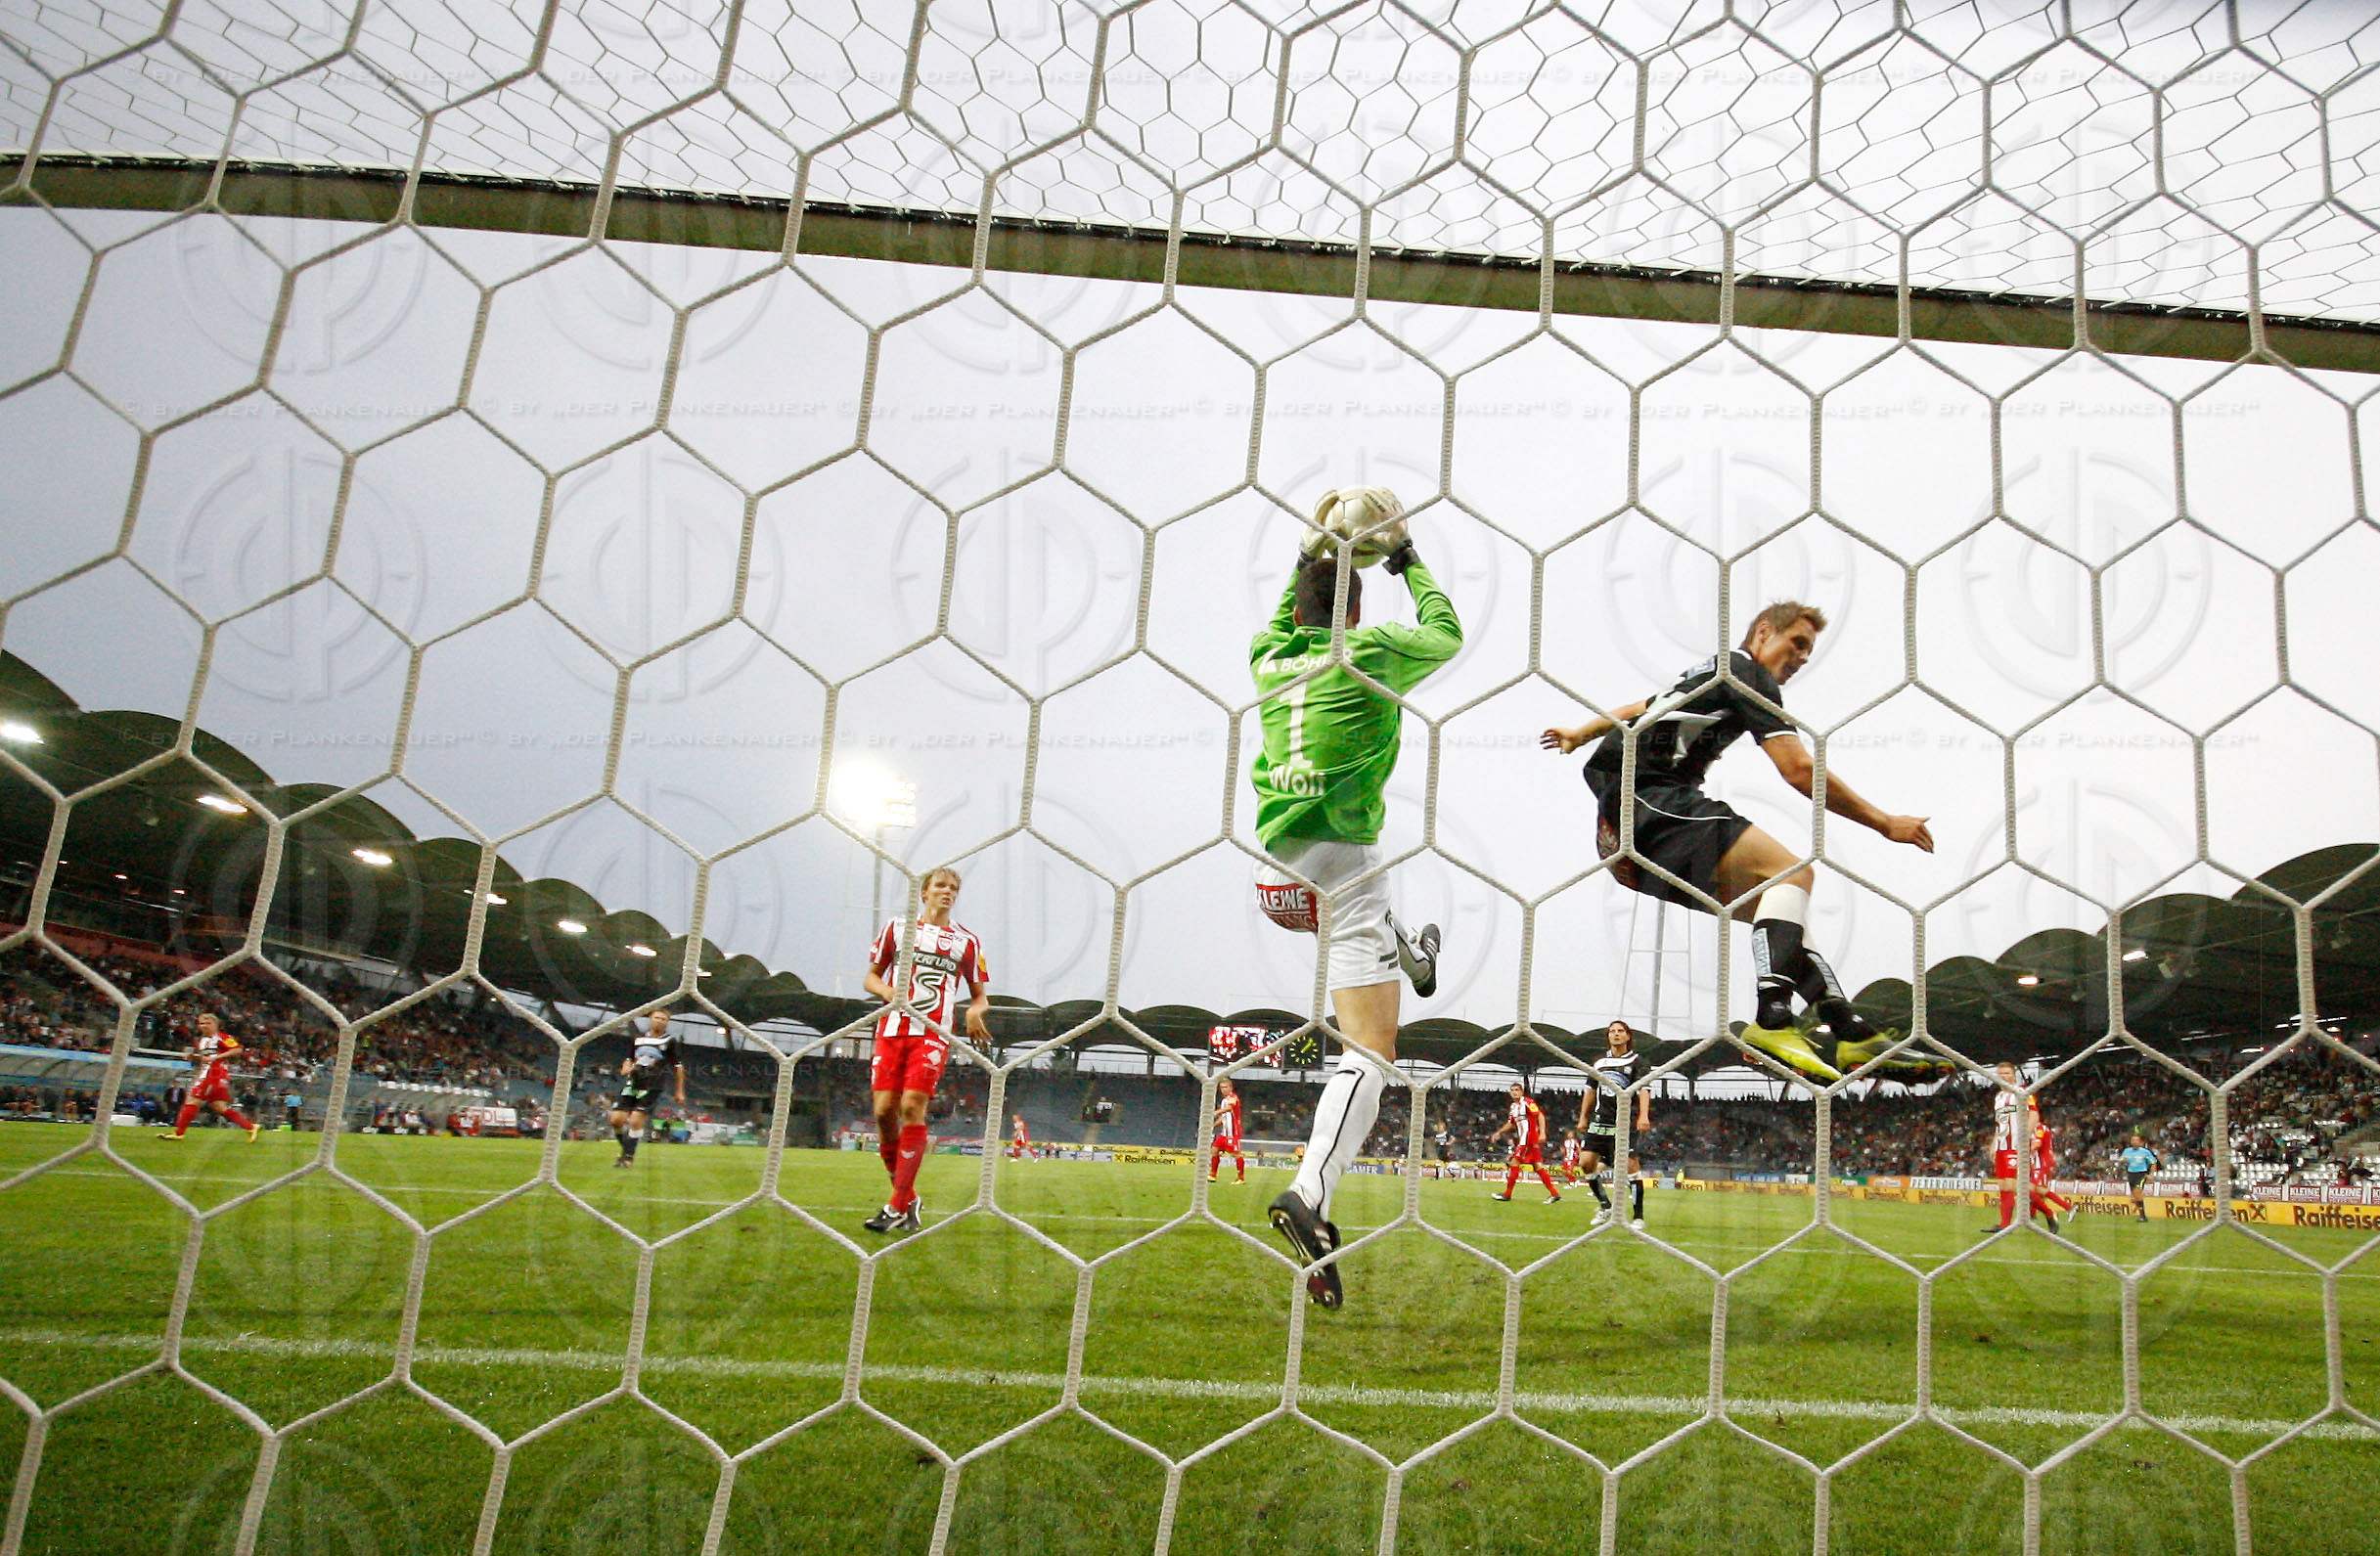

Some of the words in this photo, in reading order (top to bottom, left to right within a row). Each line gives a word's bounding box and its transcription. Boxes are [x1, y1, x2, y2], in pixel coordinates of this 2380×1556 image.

[1280, 648, 1354, 673] BÖHR
[1279, 682, 1314, 770] 1
[2290, 1186, 2320, 1196] KLEINE
[2329, 1187, 2361, 1197] KLEINE
[2165, 1200, 2250, 1222] Raiffeien
[2293, 1203, 2380, 1230] Raiffeise
